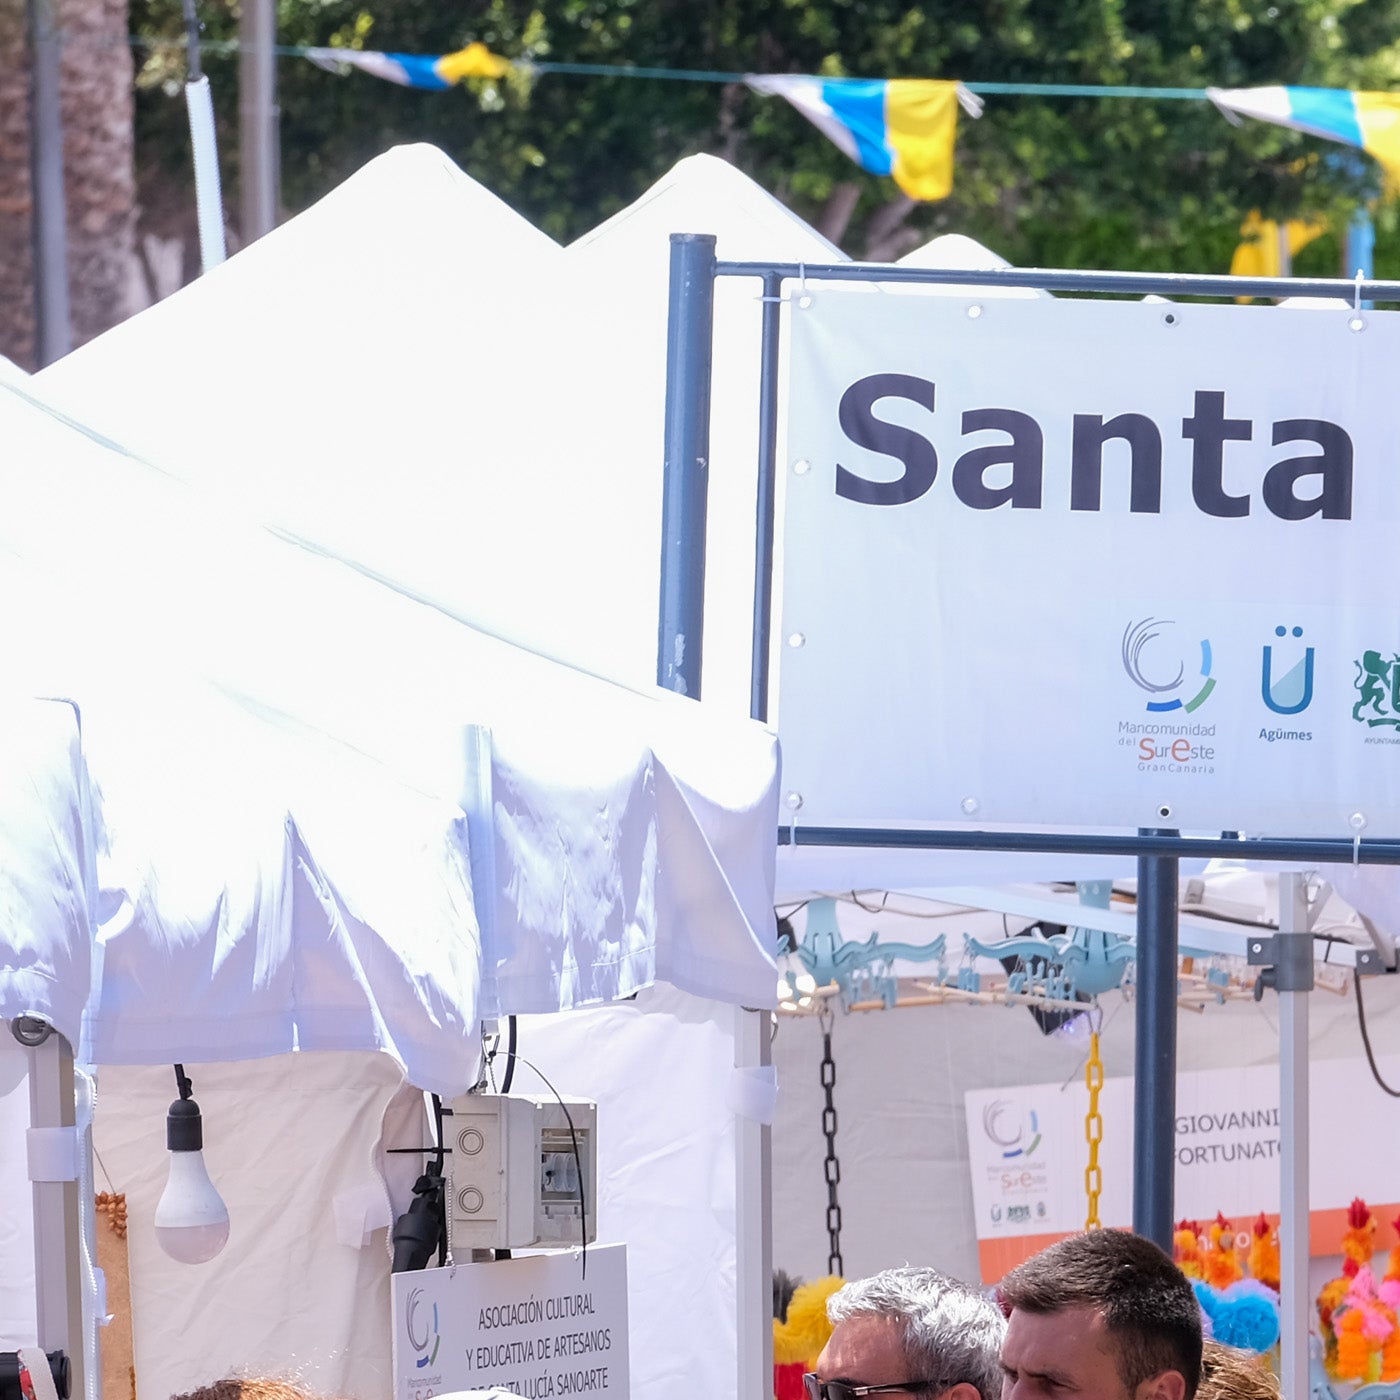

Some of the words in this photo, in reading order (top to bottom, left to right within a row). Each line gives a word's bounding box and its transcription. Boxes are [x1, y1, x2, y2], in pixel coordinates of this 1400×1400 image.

[836, 374, 1354, 520] Santa
[1118, 721, 1216, 736] Mancomunidad
[1118, 737, 1136, 746] del
[1175, 1108, 1280, 1134] GIOVANNI
[1174, 1140, 1281, 1165] ORTUNAT
[478, 1294, 543, 1330] ASOCIACIÓN
[546, 1293, 595, 1320] CULTURAL
[465, 1349, 473, 1370] Y
[477, 1340, 534, 1369] EDUCATIVA
[538, 1338, 551, 1359] DE
[554, 1329, 611, 1358] ARTESANOS
[524, 1369, 554, 1400] LUCÍA
[557, 1367, 609, 1396] SANOARTE
